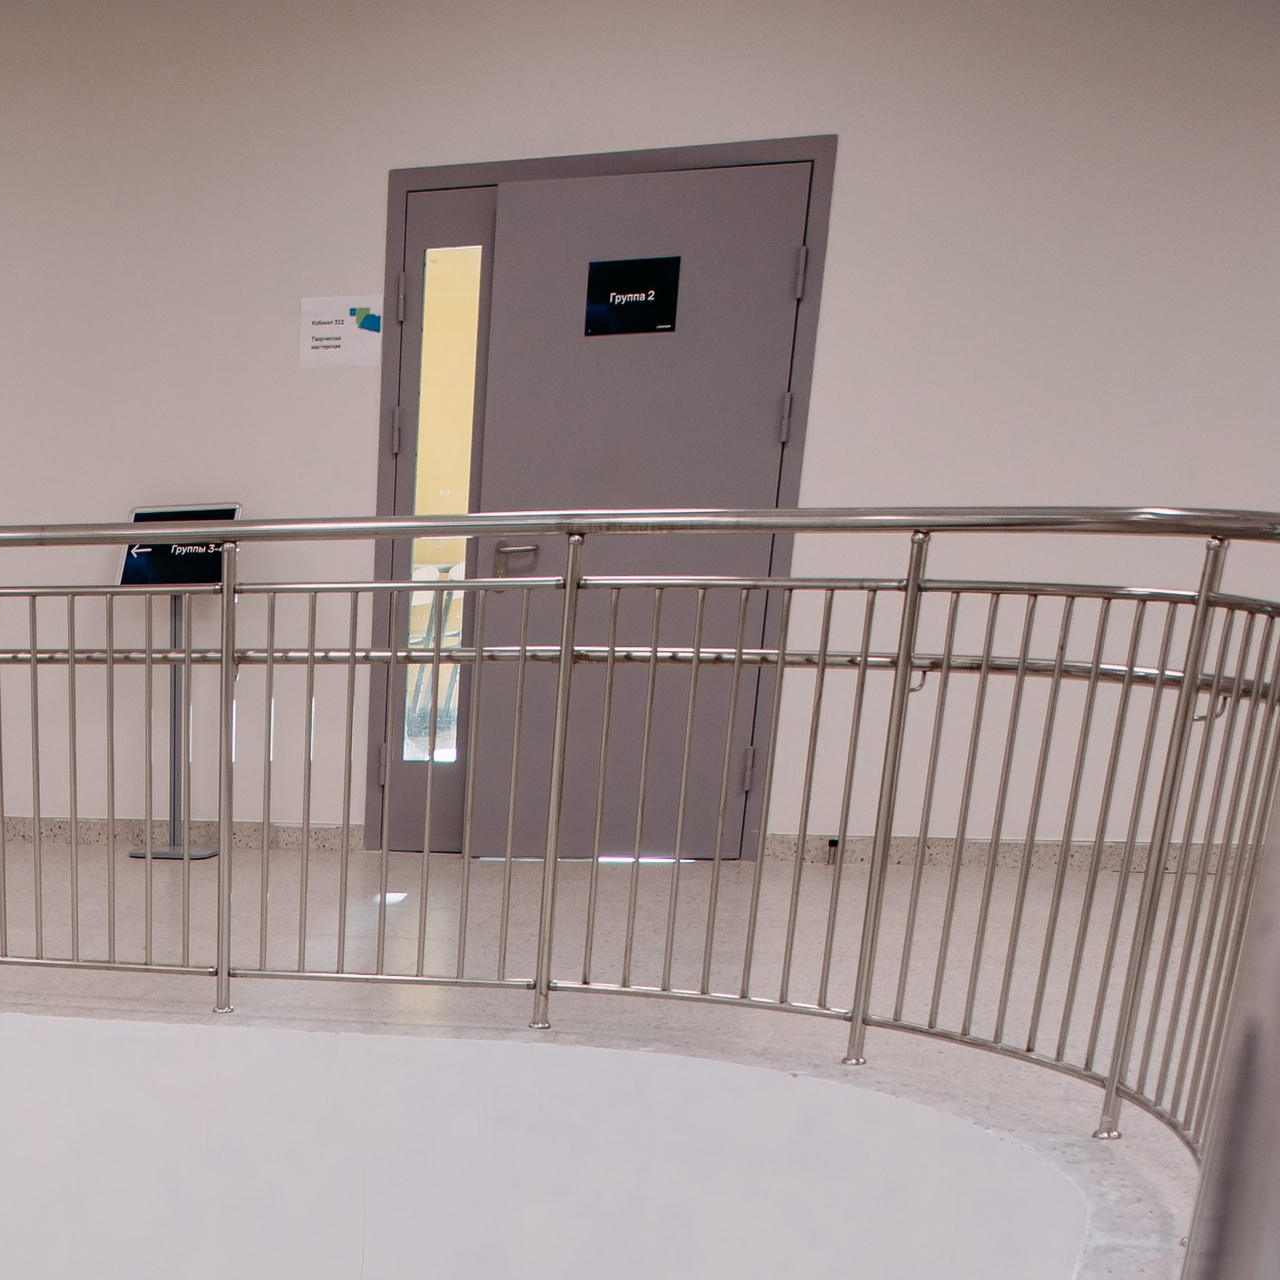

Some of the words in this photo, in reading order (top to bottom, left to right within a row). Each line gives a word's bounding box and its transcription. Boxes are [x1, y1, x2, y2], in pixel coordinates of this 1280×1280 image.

[609, 292, 646, 305] Группа
[647, 290, 656, 301] 2
[171, 544, 207, 556] Группы
